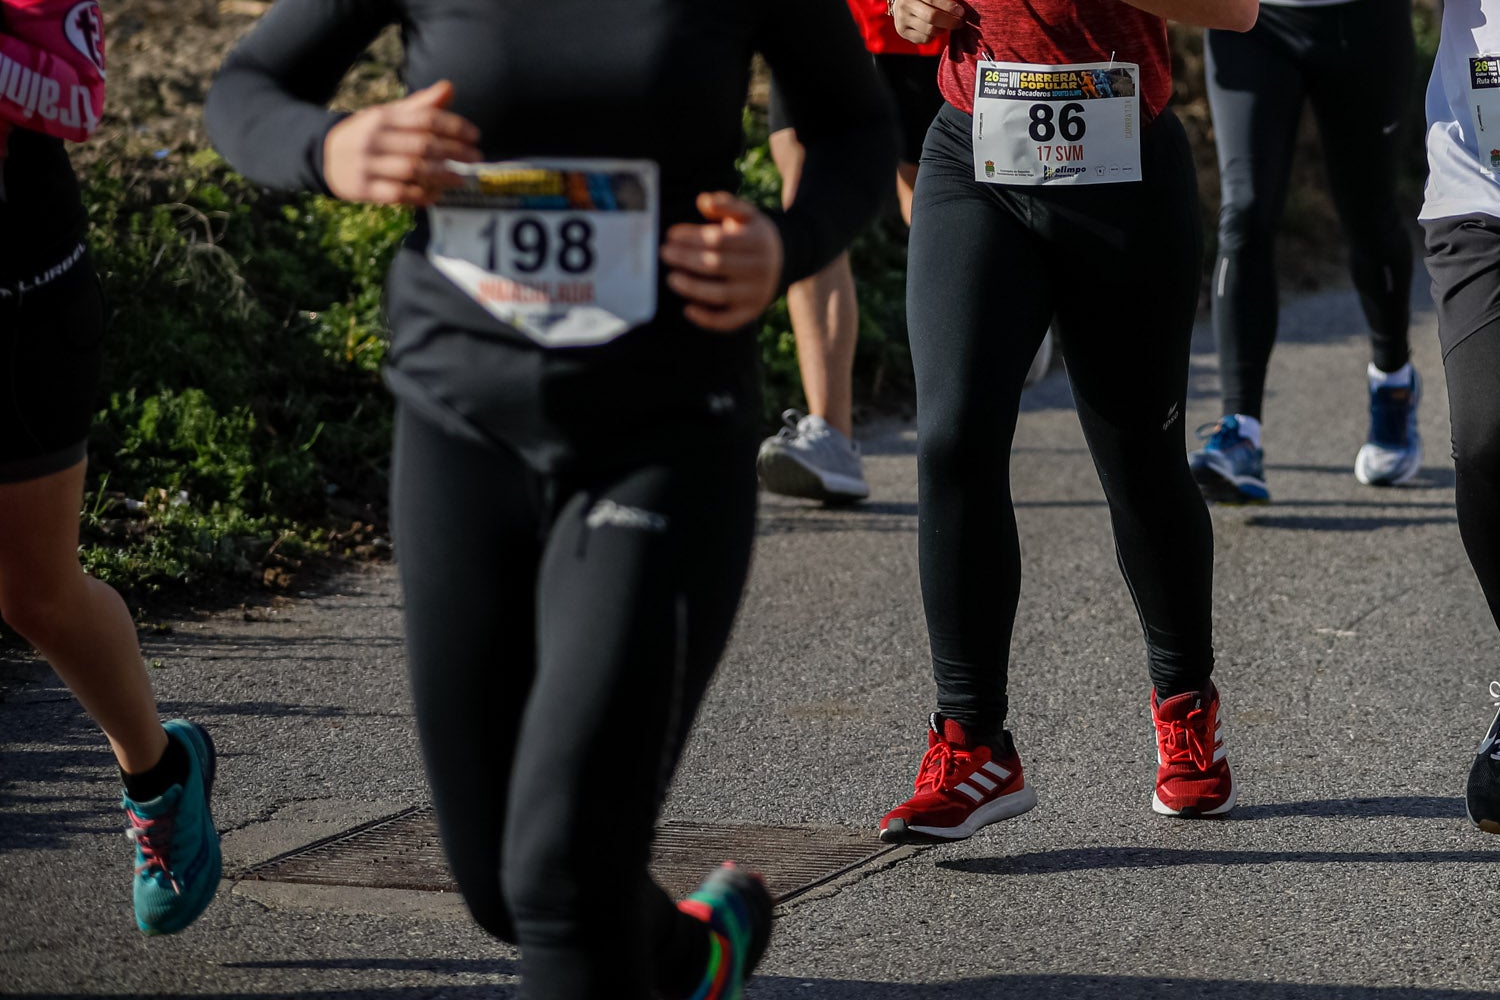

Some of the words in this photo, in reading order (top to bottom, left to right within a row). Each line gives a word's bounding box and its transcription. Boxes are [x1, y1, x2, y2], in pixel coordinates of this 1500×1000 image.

[1475, 61, 1488, 72] 26
[984, 70, 999, 82] 26
[1009, 72, 1020, 88] VII
[1020, 72, 1078, 82] CARRERA
[1476, 77, 1490, 85] Ruta
[1490, 76, 1497, 84] de
[1020, 81, 1078, 90] POPULAR
[983, 87, 998, 95] Ruta
[1006, 88, 1016, 96] los
[1017, 89, 1051, 97] Secaderos
[1028, 102, 1086, 142] 86
[1037, 146, 1051, 161] 17
[1055, 144, 1084, 161] SVM
[1055, 165, 1087, 174] olimpo
[479, 215, 596, 274] 198
